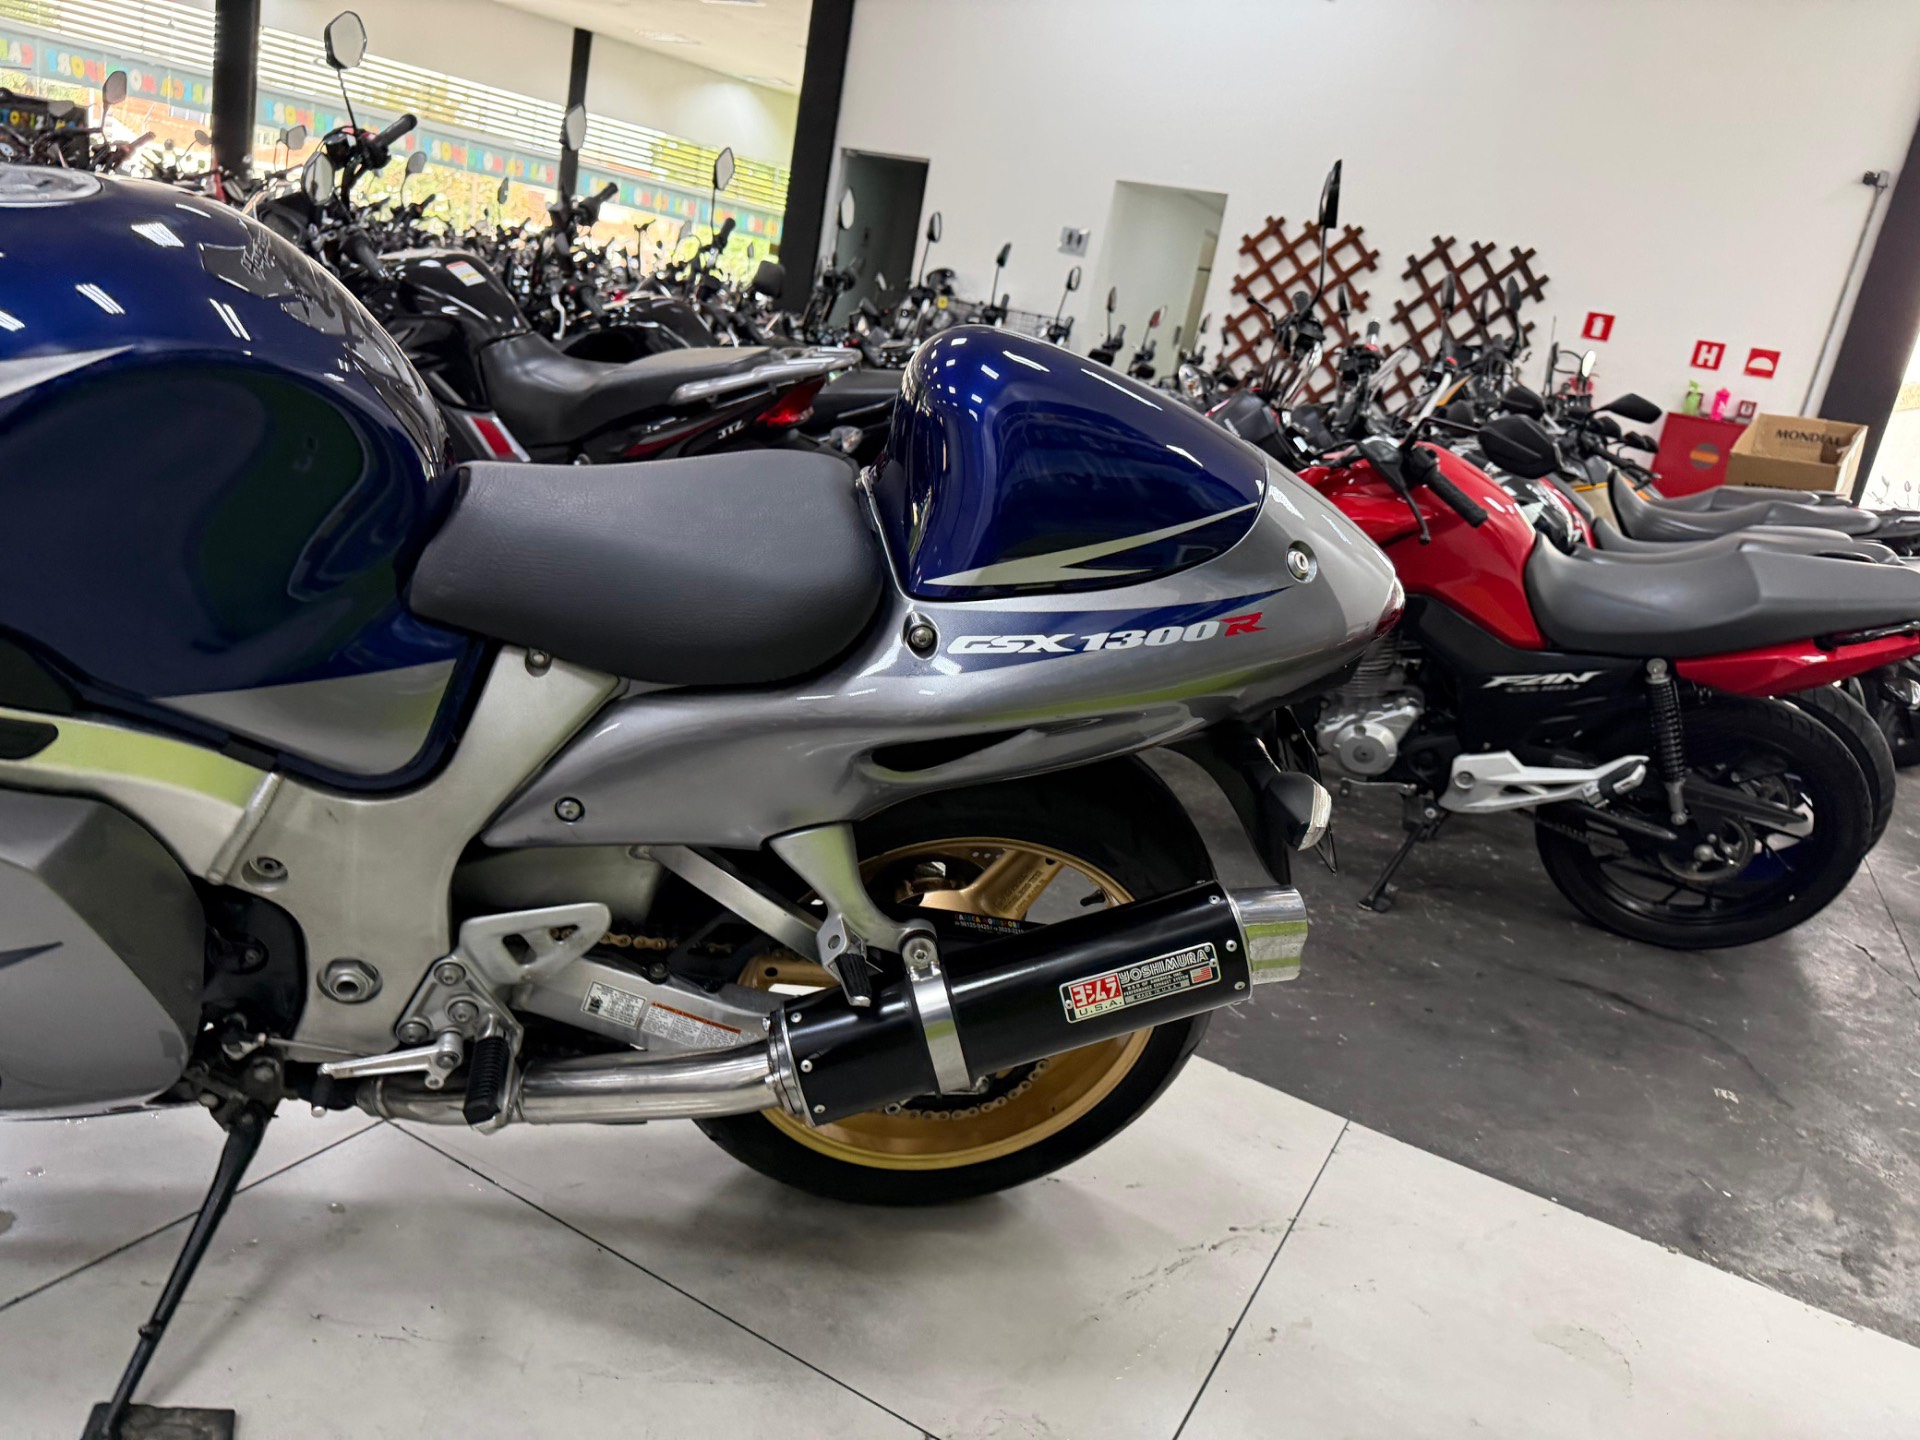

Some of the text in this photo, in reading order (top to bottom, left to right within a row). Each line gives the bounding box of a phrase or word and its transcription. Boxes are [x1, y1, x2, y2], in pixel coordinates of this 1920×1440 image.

[1696, 344, 1719, 367] H
[1776, 429, 1840, 445] MONDIAL
[1481, 671, 1605, 688] FAN
[1074, 977, 1120, 1007] ヨシムラ
[1079, 999, 1122, 1016] U.S.A.
